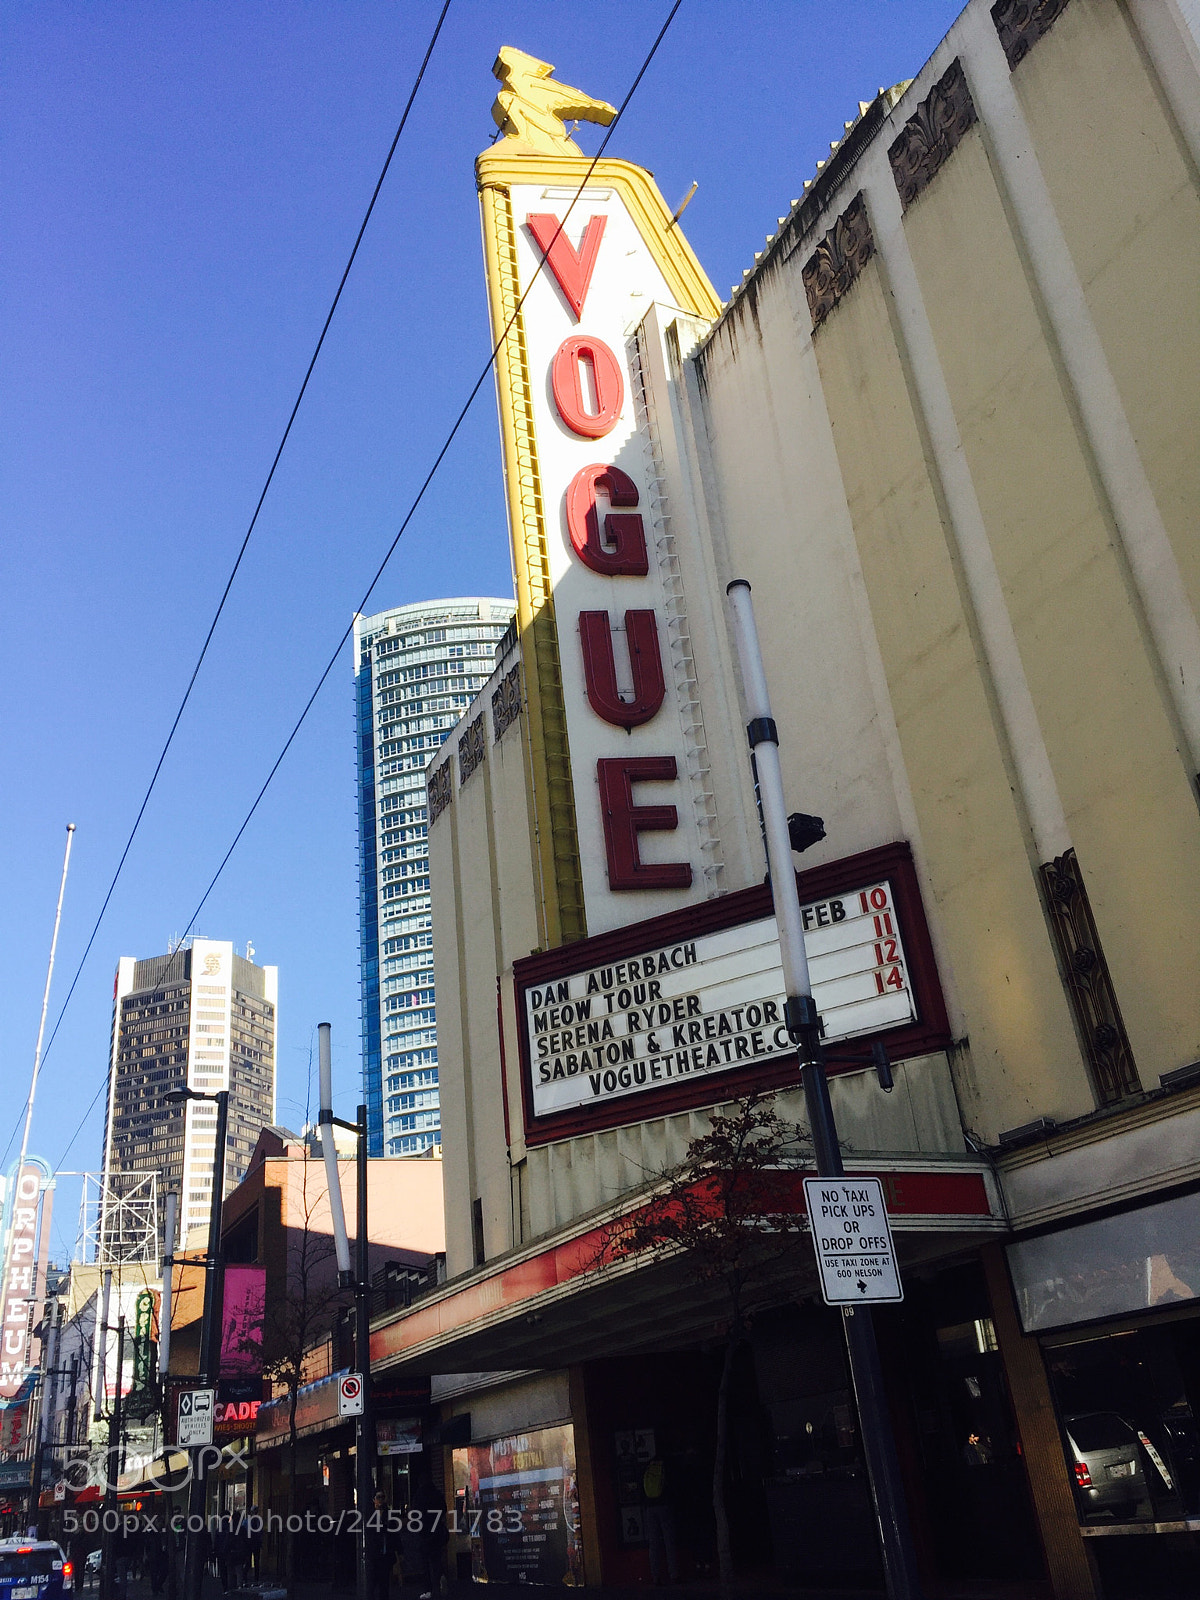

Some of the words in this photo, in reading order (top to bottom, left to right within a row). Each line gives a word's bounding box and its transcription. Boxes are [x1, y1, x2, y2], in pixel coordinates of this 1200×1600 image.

[526, 212, 693, 891] VOGUE
[801, 900, 846, 930] FEB
[859, 888, 887, 914] 10
[873, 913, 893, 938] 11
[874, 939, 899, 966] 12
[531, 981, 570, 1010] DAN
[587, 942, 698, 995] AUERBACH
[874, 966, 903, 994] 14
[533, 999, 592, 1034] MEOW
[604, 980, 663, 1013] TOUR
[537, 1018, 615, 1058] SERENA
[627, 995, 702, 1033] RYDER
[539, 1038, 635, 1083] SABATON
[647, 1031, 661, 1054] &
[672, 1001, 780, 1048] KREATOR
[821, 1190, 839, 1203] NO
[844, 1189, 870, 1202] TAXI
[821, 1205, 848, 1218] PICK
[853, 1204, 875, 1217] UPS
[843, 1220, 860, 1233] OR
[822, 1237, 853, 1251] DROP
[860, 1236, 887, 1249] OFFS
[825, 1259, 839, 1268] USE
[841, 1259, 858, 1267] TAXI
[860, 1258, 879, 1267] ZONE
[882, 1257, 890, 1266] AT
[837, 1269, 852, 1278] 600
[855, 1268, 883, 1278] NELSON
[0, 1174, 39, 1387] ORPHEUM
[181, 1415, 211, 1424] AUTHORIZED
[184, 1422, 206, 1430] VEHICLES
